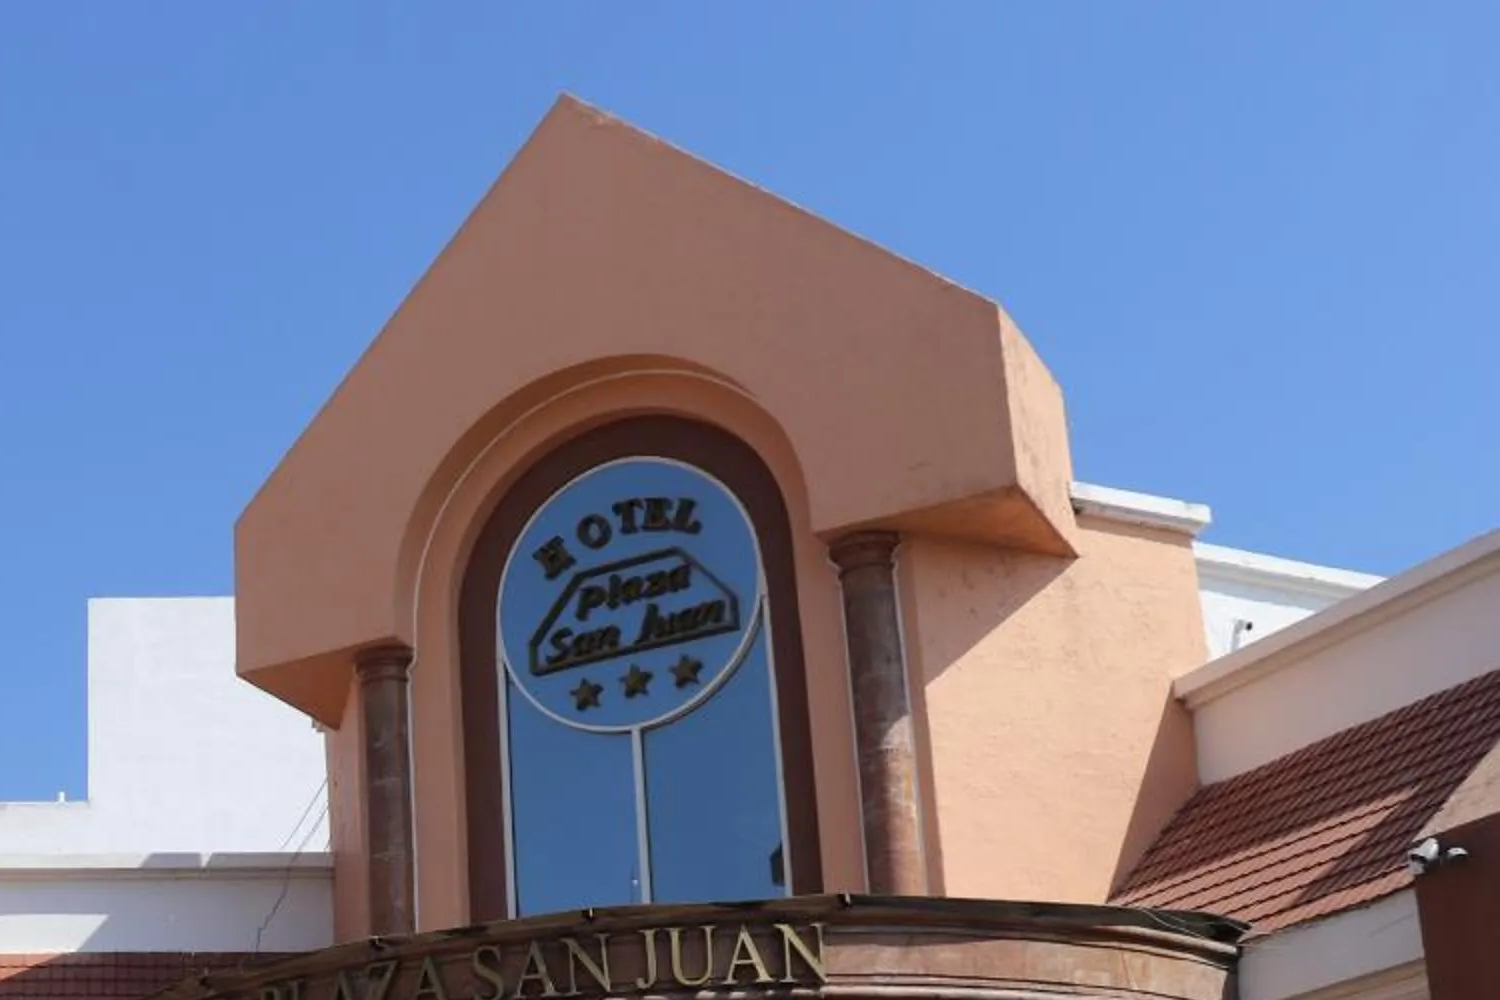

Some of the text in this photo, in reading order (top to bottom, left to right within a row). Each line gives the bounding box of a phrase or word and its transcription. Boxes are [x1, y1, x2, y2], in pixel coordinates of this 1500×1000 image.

[532, 497, 702, 581] HOTEL
[545, 624, 621, 665] San
[635, 922, 831, 998] JUAN
